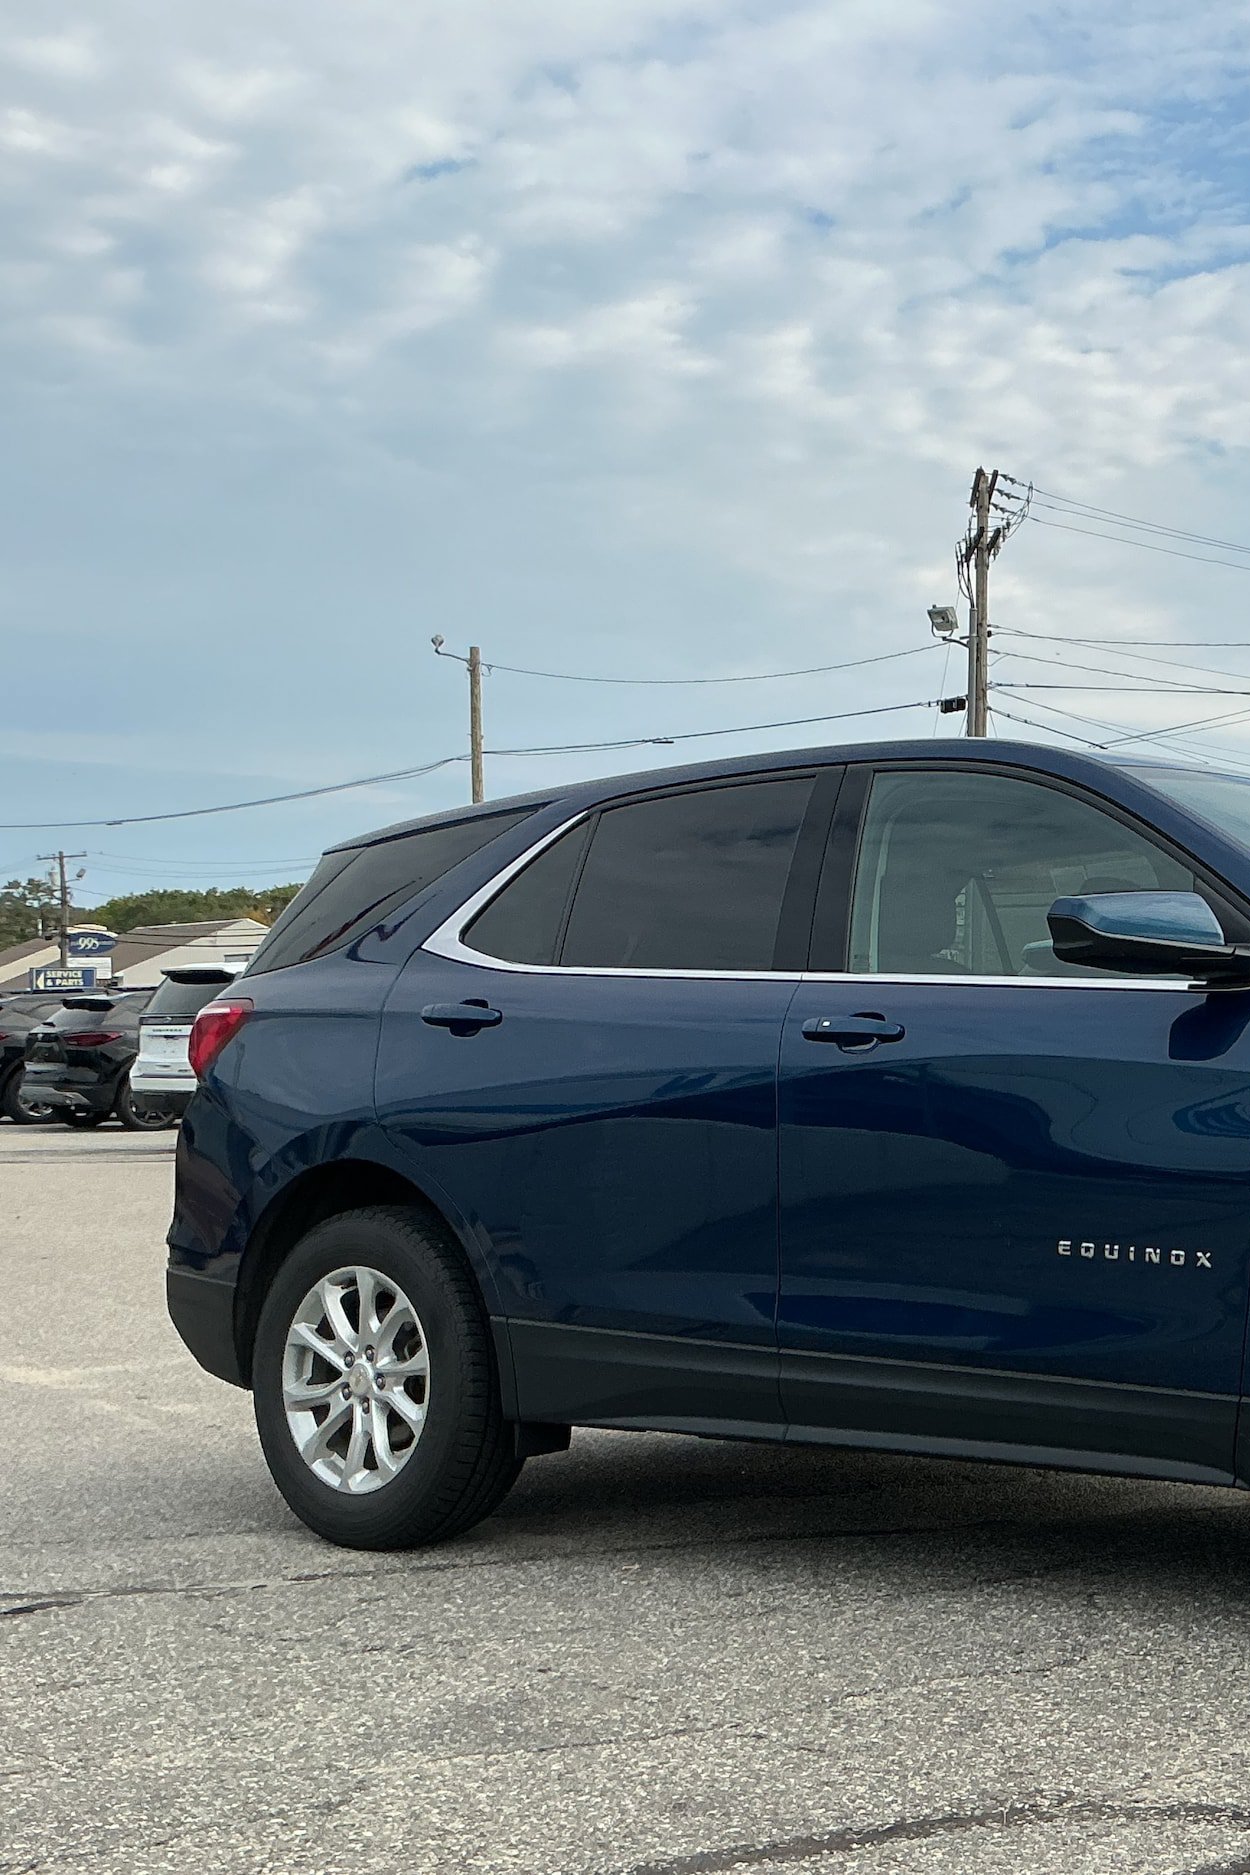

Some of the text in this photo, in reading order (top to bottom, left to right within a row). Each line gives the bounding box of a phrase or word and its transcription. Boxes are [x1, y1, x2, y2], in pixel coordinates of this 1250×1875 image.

[46, 970, 82, 978] SERVICE
[46, 978, 84, 986] & PARTS
[1057, 1240, 1212, 1269] EQUINOX
